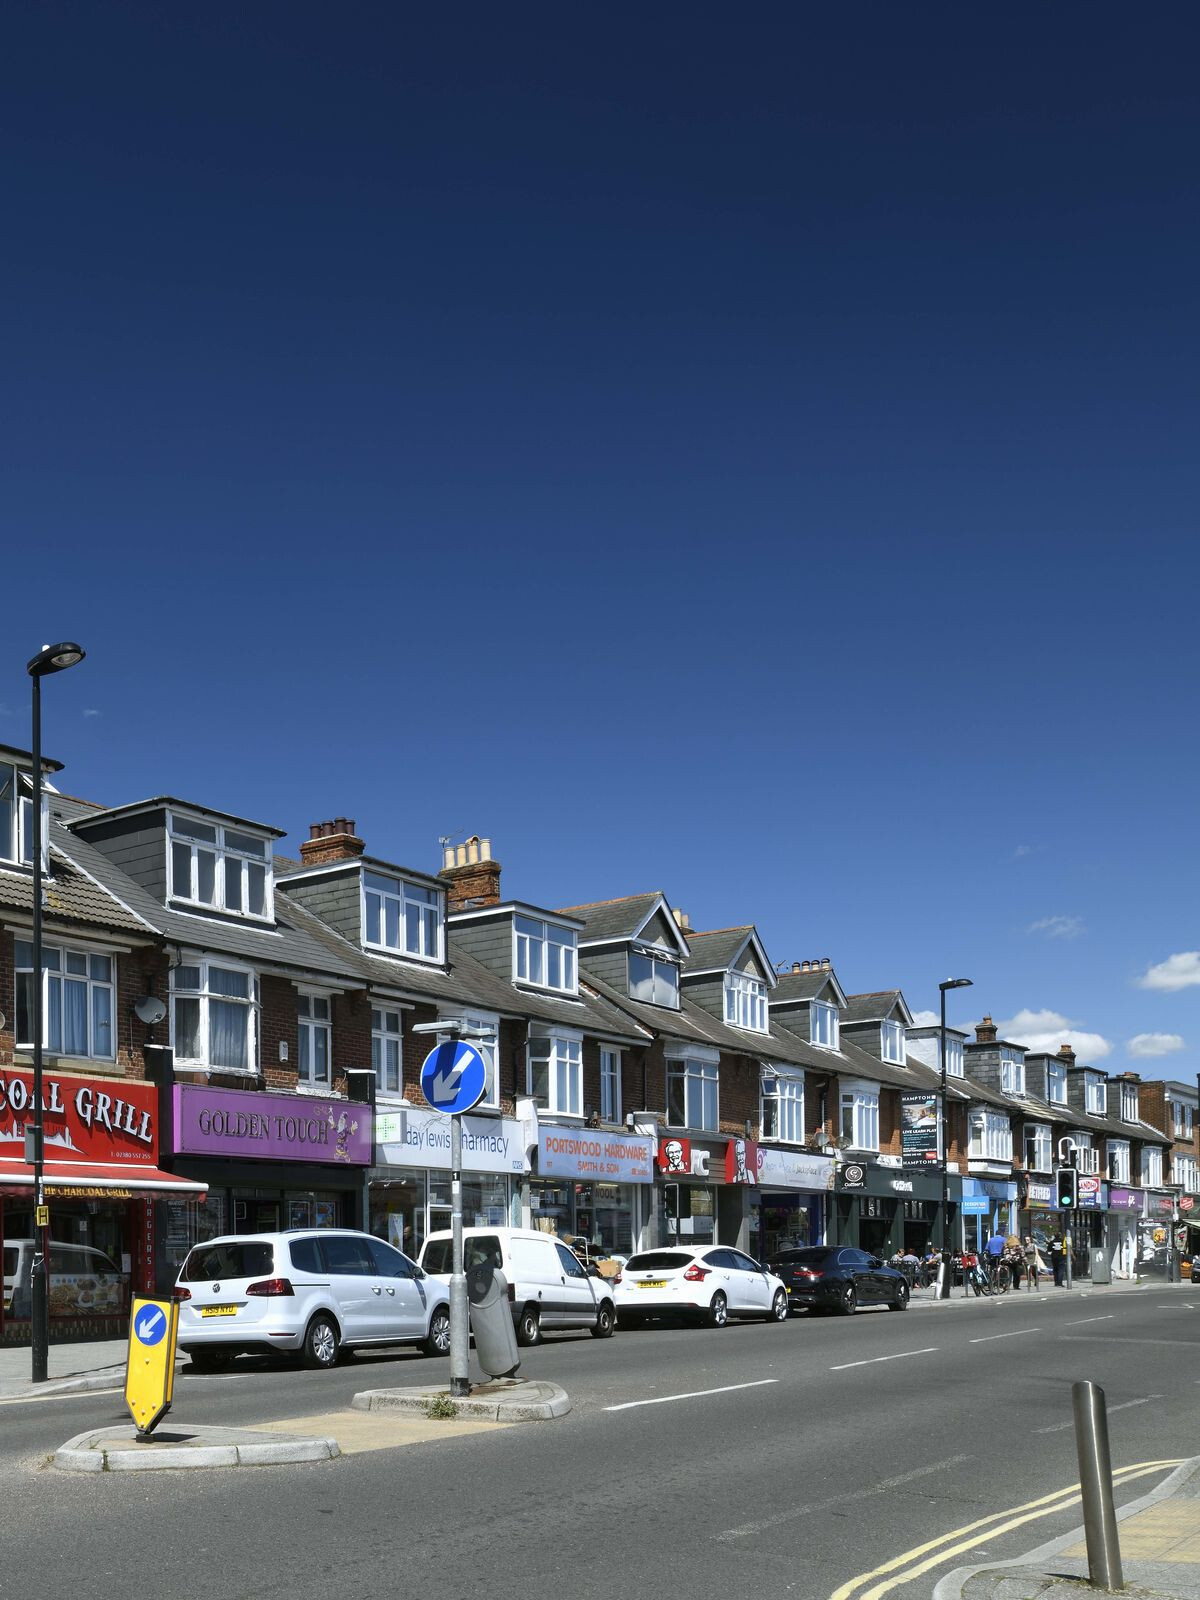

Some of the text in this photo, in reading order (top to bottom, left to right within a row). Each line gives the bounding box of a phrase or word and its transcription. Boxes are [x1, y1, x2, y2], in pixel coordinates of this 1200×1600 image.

[75, 1087, 153, 1143] GRILL
[200, 1109, 329, 1145] GOLDEN TOUCH
[406, 1127, 510, 1159] day lewis harmacy
[546, 1136, 647, 1161] PORTSWOOD HARDWARE
[513, 1161, 524, 1169] NHS
[577, 1161, 619, 1173] SMITH & SON
[690, 1149, 710, 1176] FC
[452, 1172, 458, 1180] 1
[44, 1186, 132, 1198] HE CHARCOAL GRILL
[39, 1208, 48, 1225] H
